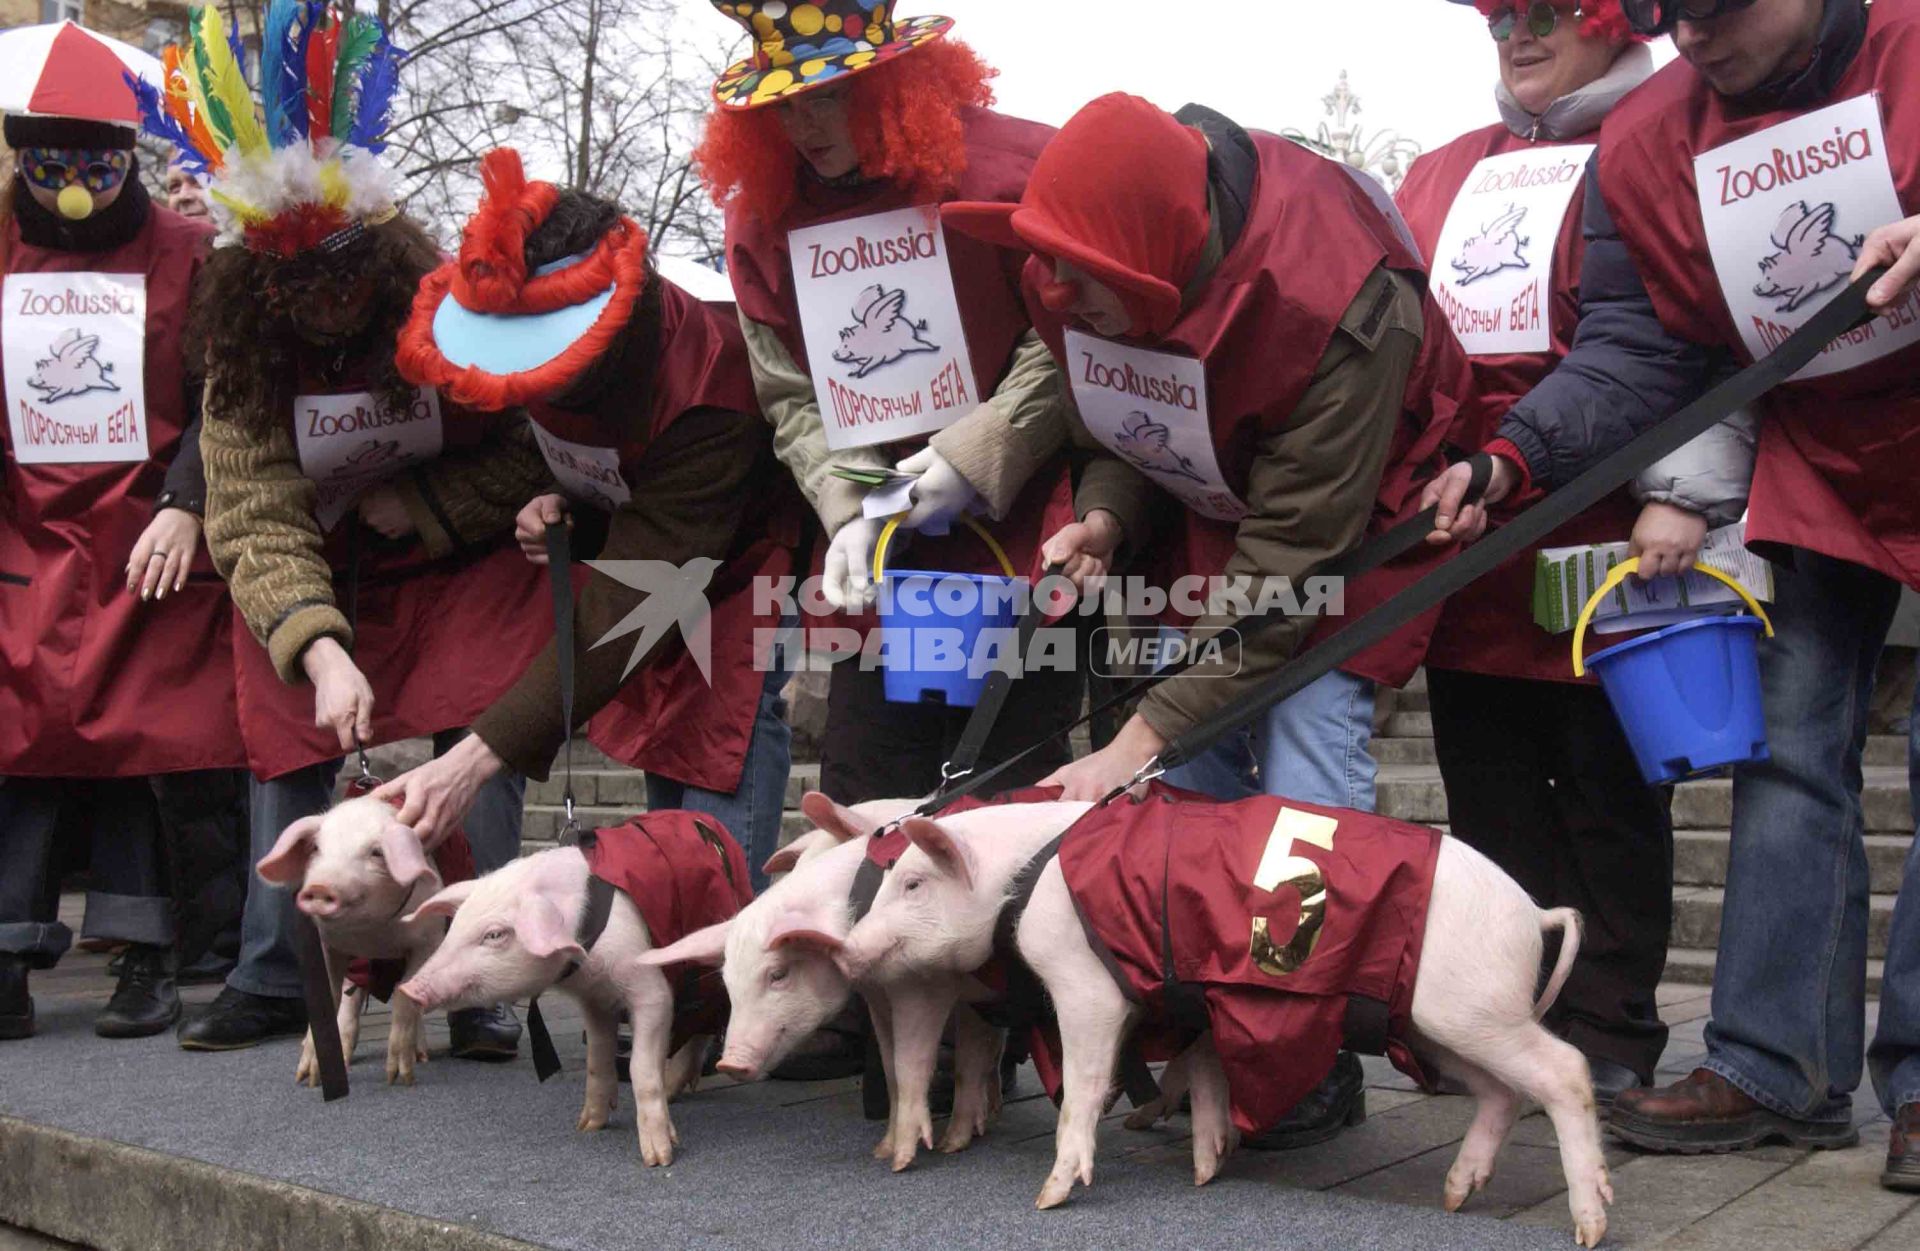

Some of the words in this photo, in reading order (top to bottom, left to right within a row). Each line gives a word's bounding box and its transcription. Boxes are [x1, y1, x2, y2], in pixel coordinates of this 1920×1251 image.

[1471, 158, 1580, 195] ZooRussia
[1717, 126, 1872, 206] ZooRussia
[807, 227, 938, 279] ZooRussia
[19, 288, 136, 316] ZooRussia
[1510, 276, 1540, 331] БЕГА
[827, 376, 923, 429] ПОРОСЯЧЬИ
[930, 357, 969, 411] БЕГА
[1082, 350, 1198, 411] ZooRussia
[20, 399, 99, 446] ПОРОСЯЧЬИ
[107, 400, 139, 444] БЕГА
[1250, 806, 1338, 976] 5
